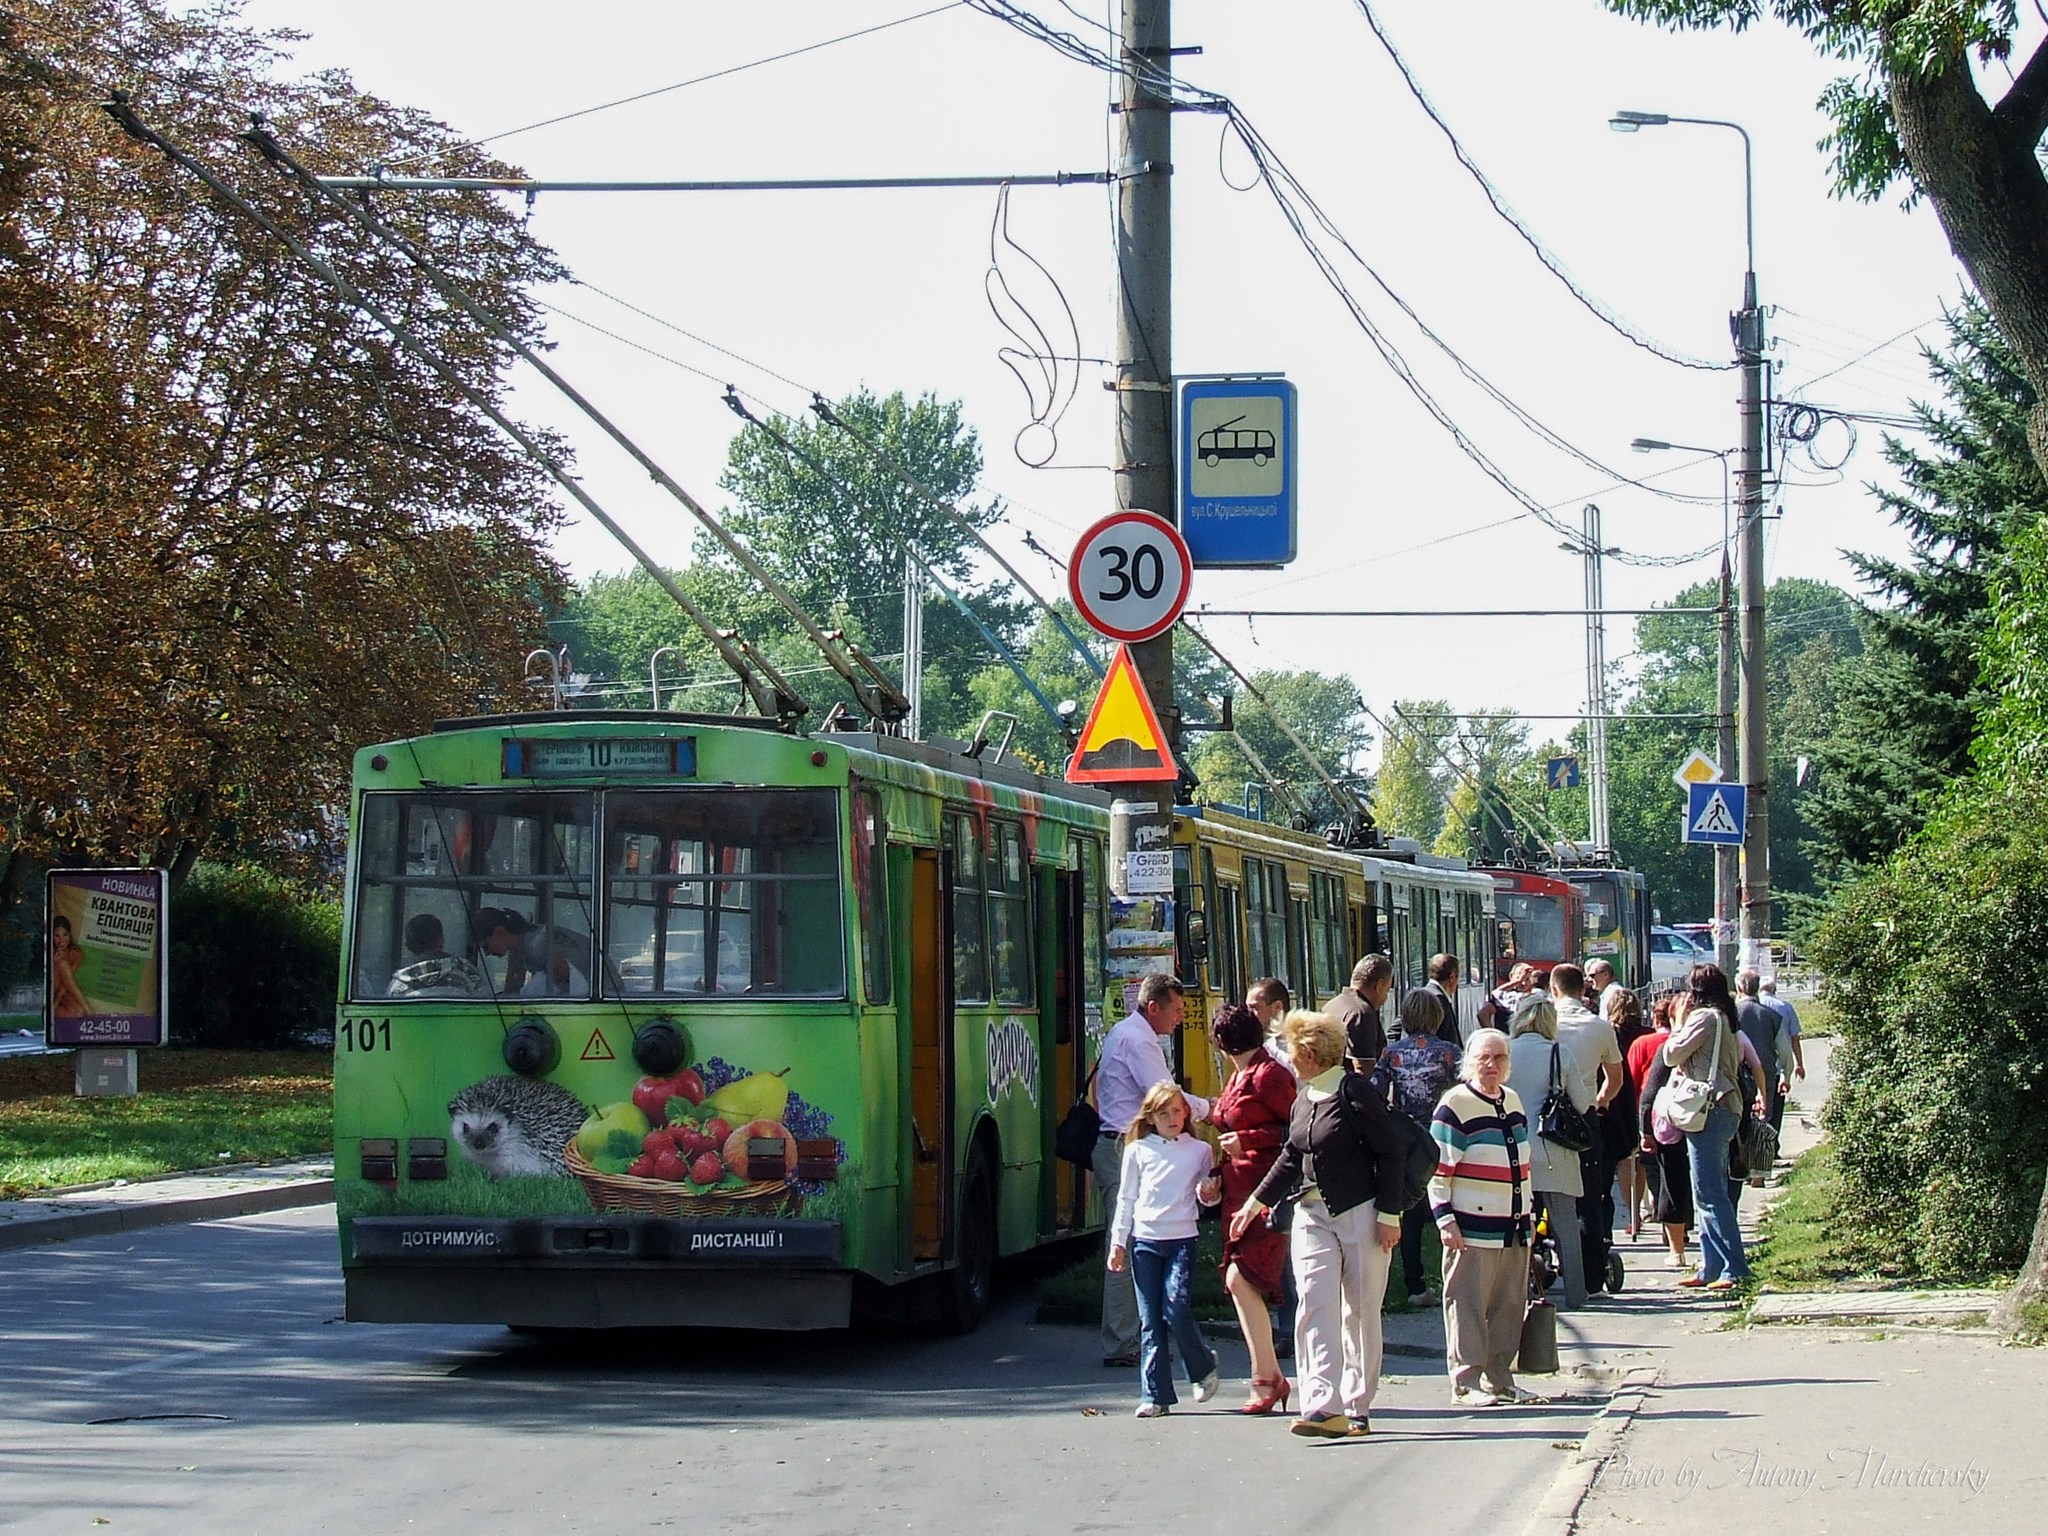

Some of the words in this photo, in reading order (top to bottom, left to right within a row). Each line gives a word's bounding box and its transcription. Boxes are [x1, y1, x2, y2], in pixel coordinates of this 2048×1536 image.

[1098, 543, 1165, 602] 30
[587, 742, 612, 767] 10
[101, 877, 156, 899] НОВИНКА
[91, 896, 156, 921] КВАНТОВА
[96, 913, 154, 936] ЕПІЛЯЦІЯ
[79, 1020, 130, 1034] 42-45-00
[341, 1018, 391, 1052] 101
[690, 1229, 776, 1250] ДИСТАНЦІЇ
